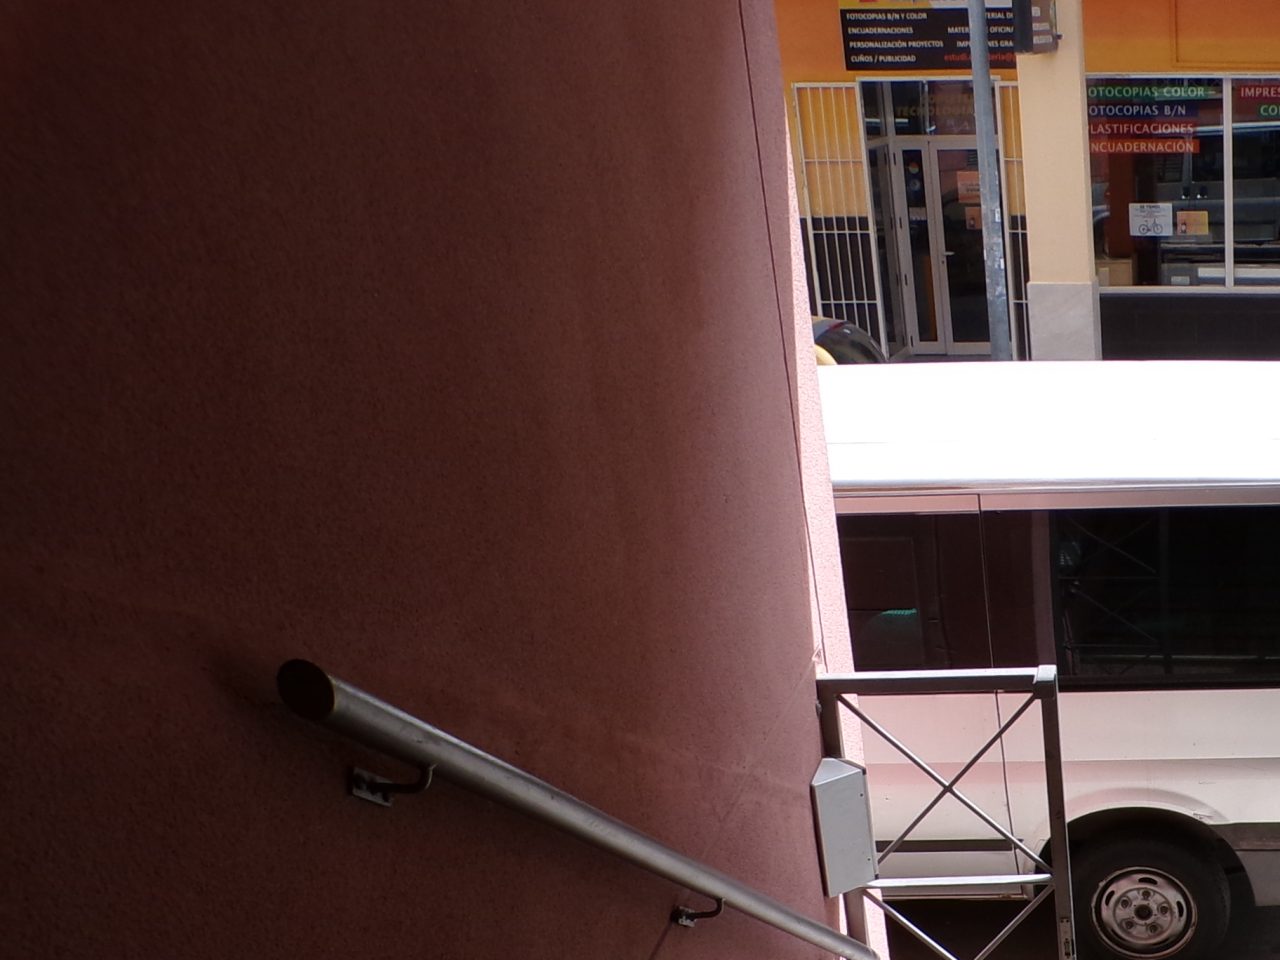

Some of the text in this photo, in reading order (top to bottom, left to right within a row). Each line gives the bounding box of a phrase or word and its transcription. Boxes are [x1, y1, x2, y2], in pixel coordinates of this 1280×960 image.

[846, 12, 886, 20] FOTOCOPIAS
[887, 12, 900, 20] B/N
[847, 26, 913, 34] ENCUADERNACIONES
[849, 40, 944, 48] PERSONALIZACIÓN PROYECTOS
[850, 54, 874, 62] CUÑOS
[879, 54, 916, 62] PUBLICIDAD
[1088, 86, 1205, 98] OTOCOPIAS COLOR
[1089, 104, 1186, 117] OTOCOPIAS B/N
[1090, 122, 1194, 135] LASTIFICACIONES
[1090, 141, 1194, 154] NCUADERNACIÓN
